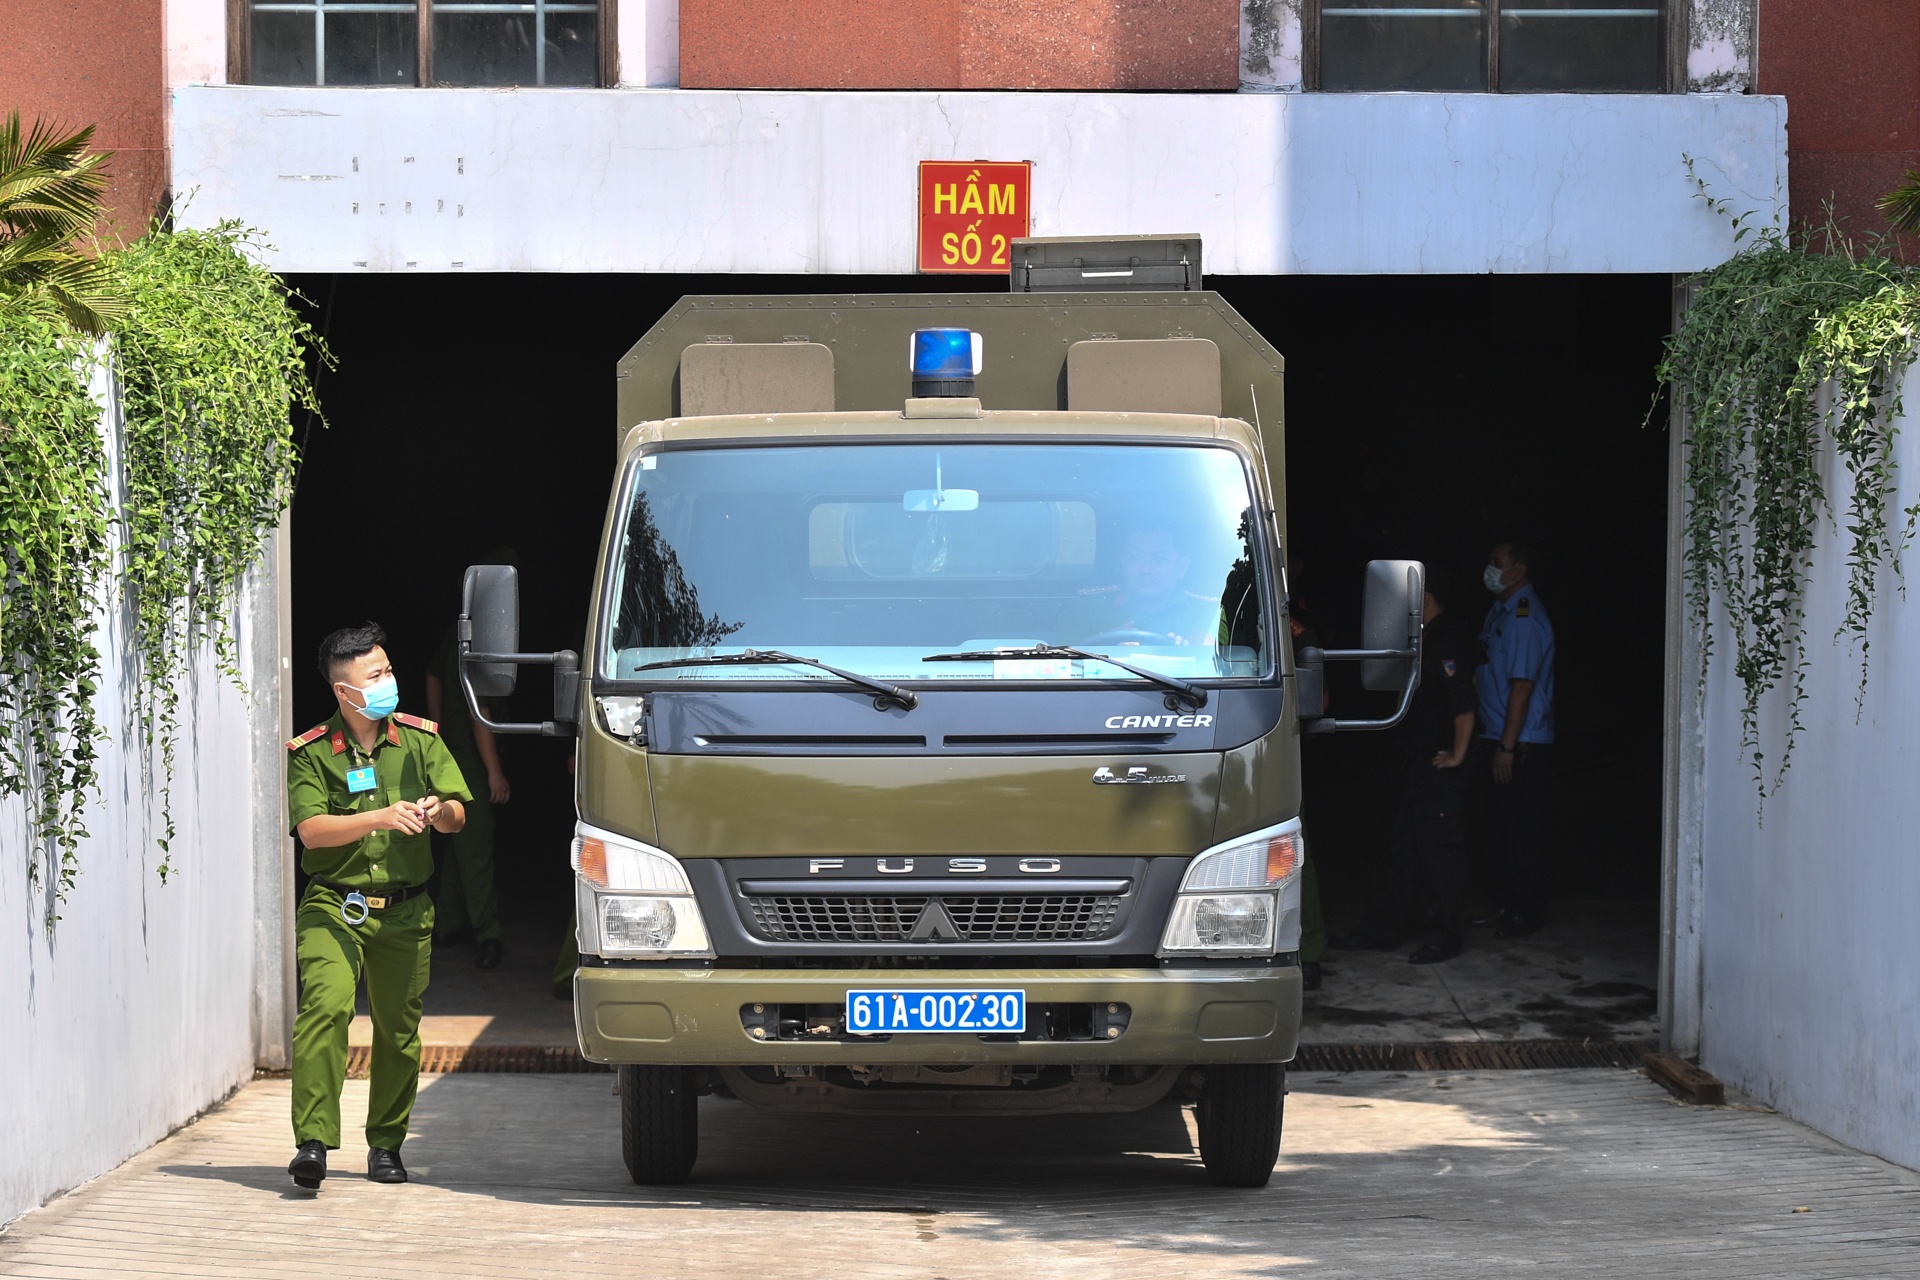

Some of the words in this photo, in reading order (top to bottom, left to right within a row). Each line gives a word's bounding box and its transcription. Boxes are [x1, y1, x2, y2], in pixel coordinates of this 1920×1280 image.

[934, 169, 1015, 214] HẦM
[942, 219, 982, 265] SỐ
[990, 234, 1005, 264] 2
[1104, 714, 1213, 728] CANTER
[809, 858, 1061, 873] FUSO
[853, 994, 1019, 1028] 61A-002.30
